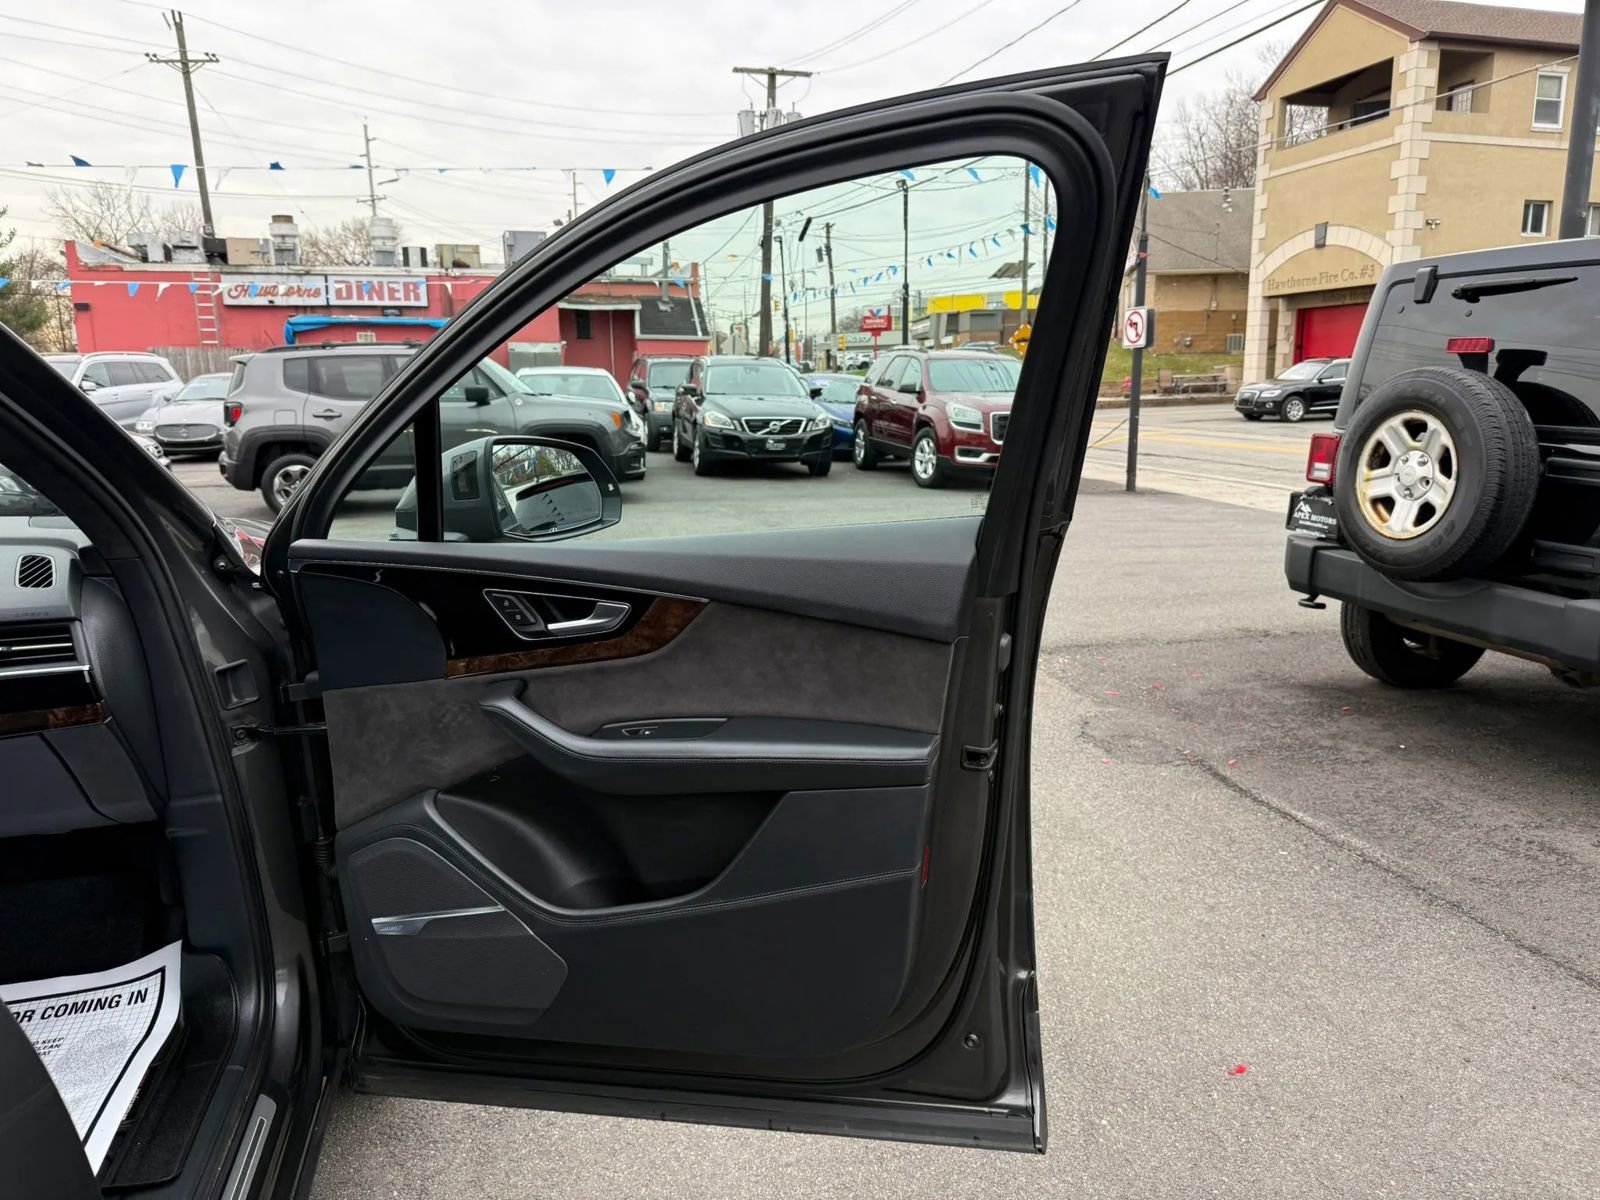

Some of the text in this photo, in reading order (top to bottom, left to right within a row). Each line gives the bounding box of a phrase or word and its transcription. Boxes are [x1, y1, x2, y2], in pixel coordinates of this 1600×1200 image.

[1267, 264, 1376, 291] Hawthorne Fire Co. #3
[334, 280, 421, 302] DINER
[1293, 511, 1311, 520] APEX
[1311, 514, 1337, 525] MOTORS
[40, 994, 123, 1020] COMING
[128, 987, 149, 1006] IN
